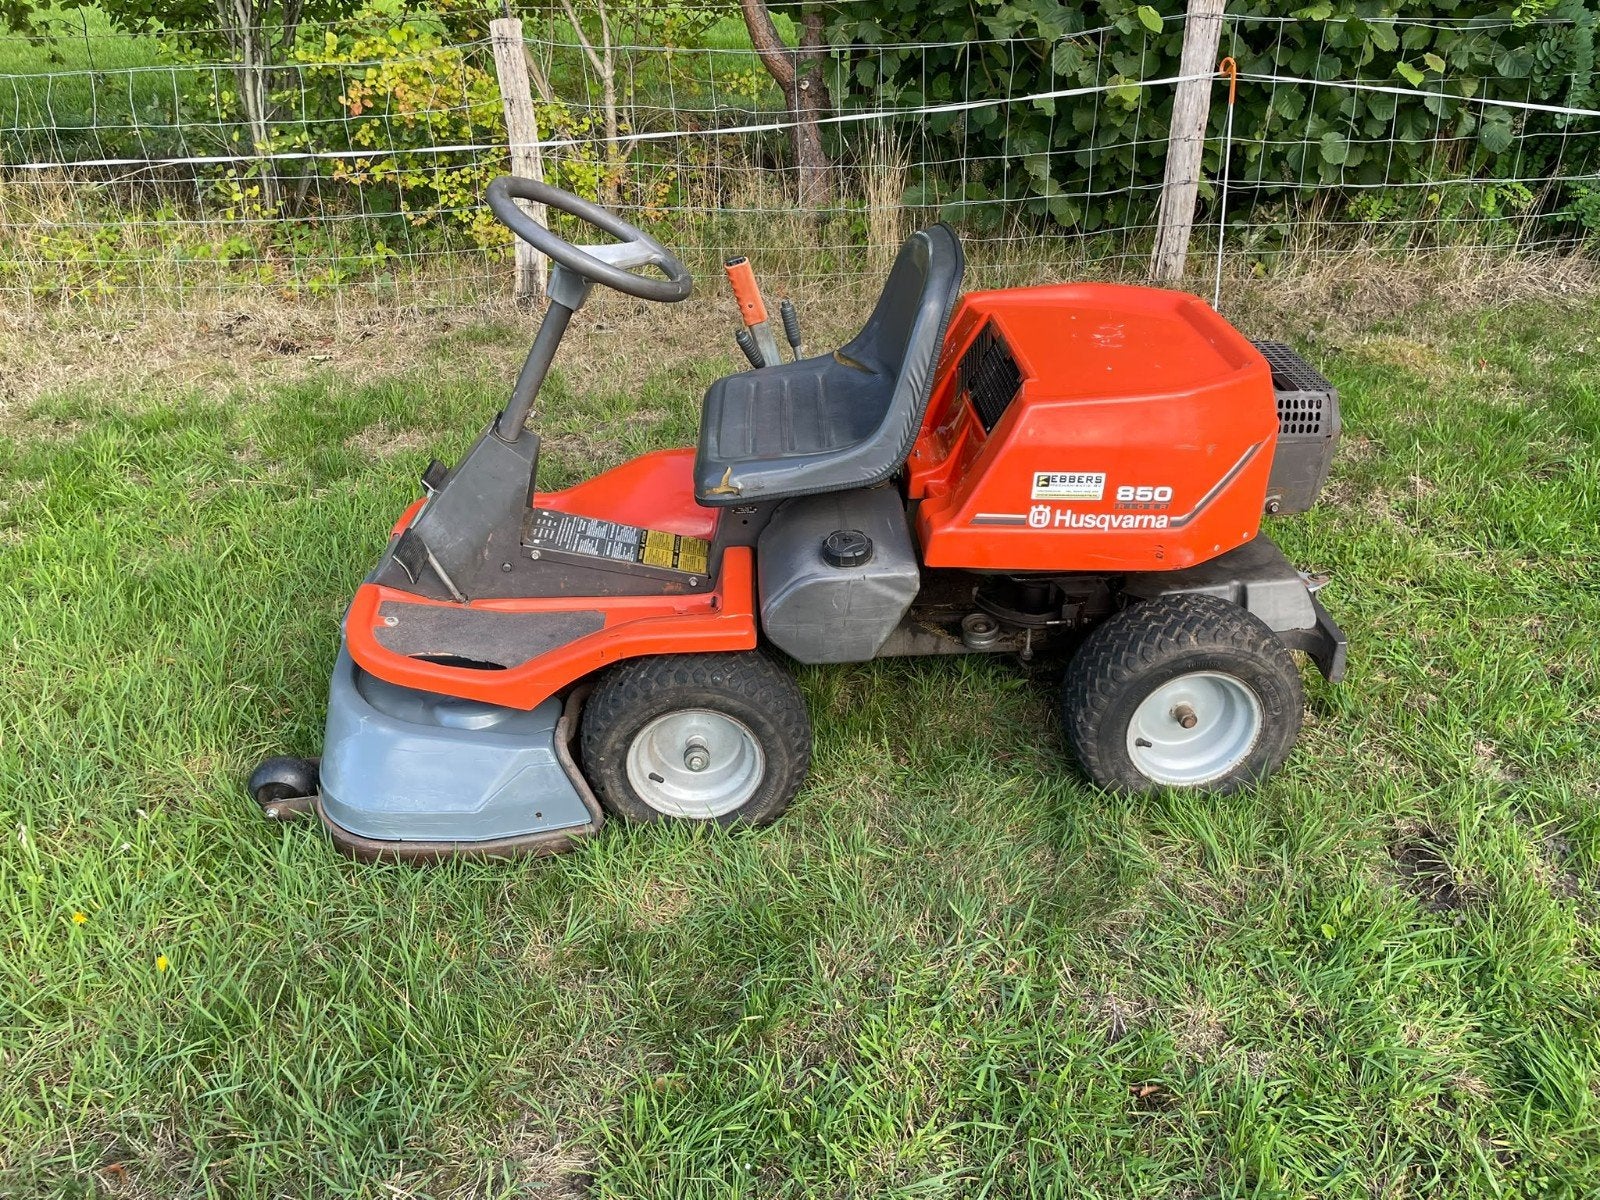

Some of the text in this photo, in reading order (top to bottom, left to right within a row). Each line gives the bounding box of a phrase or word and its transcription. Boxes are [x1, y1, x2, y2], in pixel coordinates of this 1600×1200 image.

[1050, 475, 1102, 483] EBBERS
[1116, 486, 1173, 501] 850
[1054, 509, 1168, 531] Husqvarna
